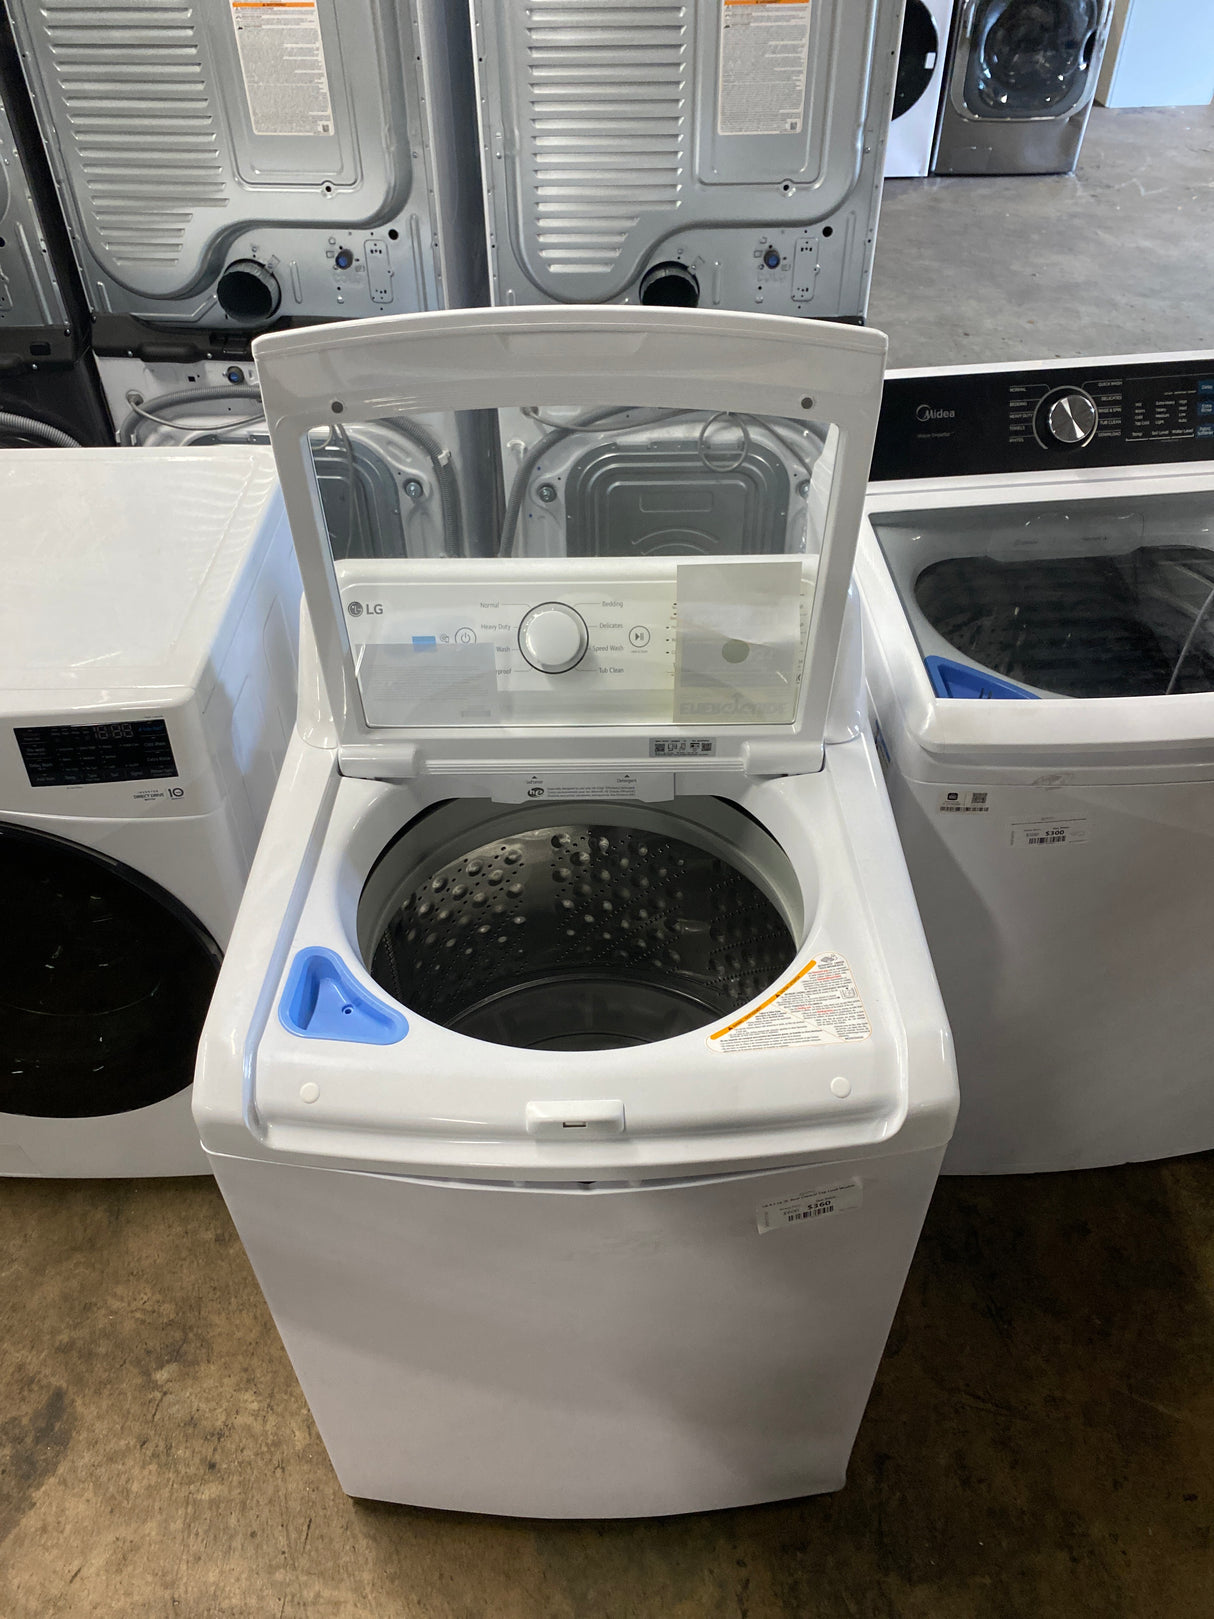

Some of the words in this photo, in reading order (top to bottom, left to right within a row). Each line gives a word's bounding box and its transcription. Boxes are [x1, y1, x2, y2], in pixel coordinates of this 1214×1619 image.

[916, 404, 955, 421] Midea
[366, 603, 384, 615] LG
[498, 623, 511, 631] Duty
[592, 645, 609, 653] Speed
[1045, 829, 1065, 837] $300
